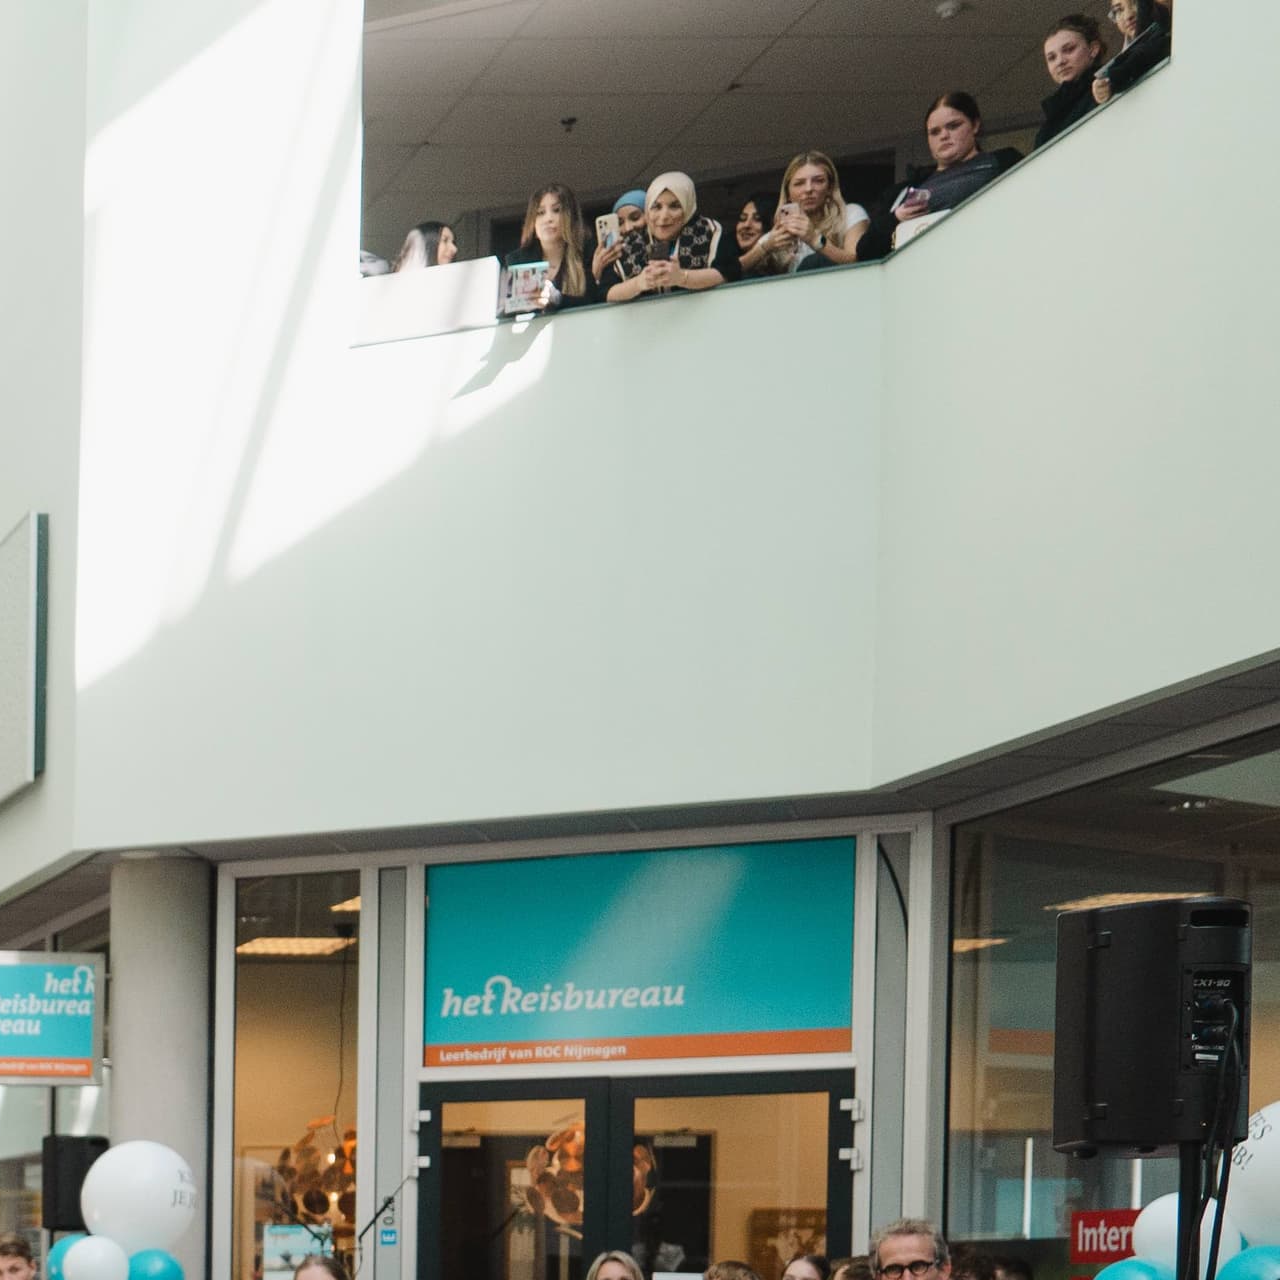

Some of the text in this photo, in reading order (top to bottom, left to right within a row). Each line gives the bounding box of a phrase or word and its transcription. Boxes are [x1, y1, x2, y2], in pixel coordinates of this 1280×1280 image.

[441, 976, 686, 1018] het Reisbureau
[440, 1044, 627, 1063] Leerbedrijf van ROC Nijmegen
[1077, 1219, 1135, 1252] Inter
